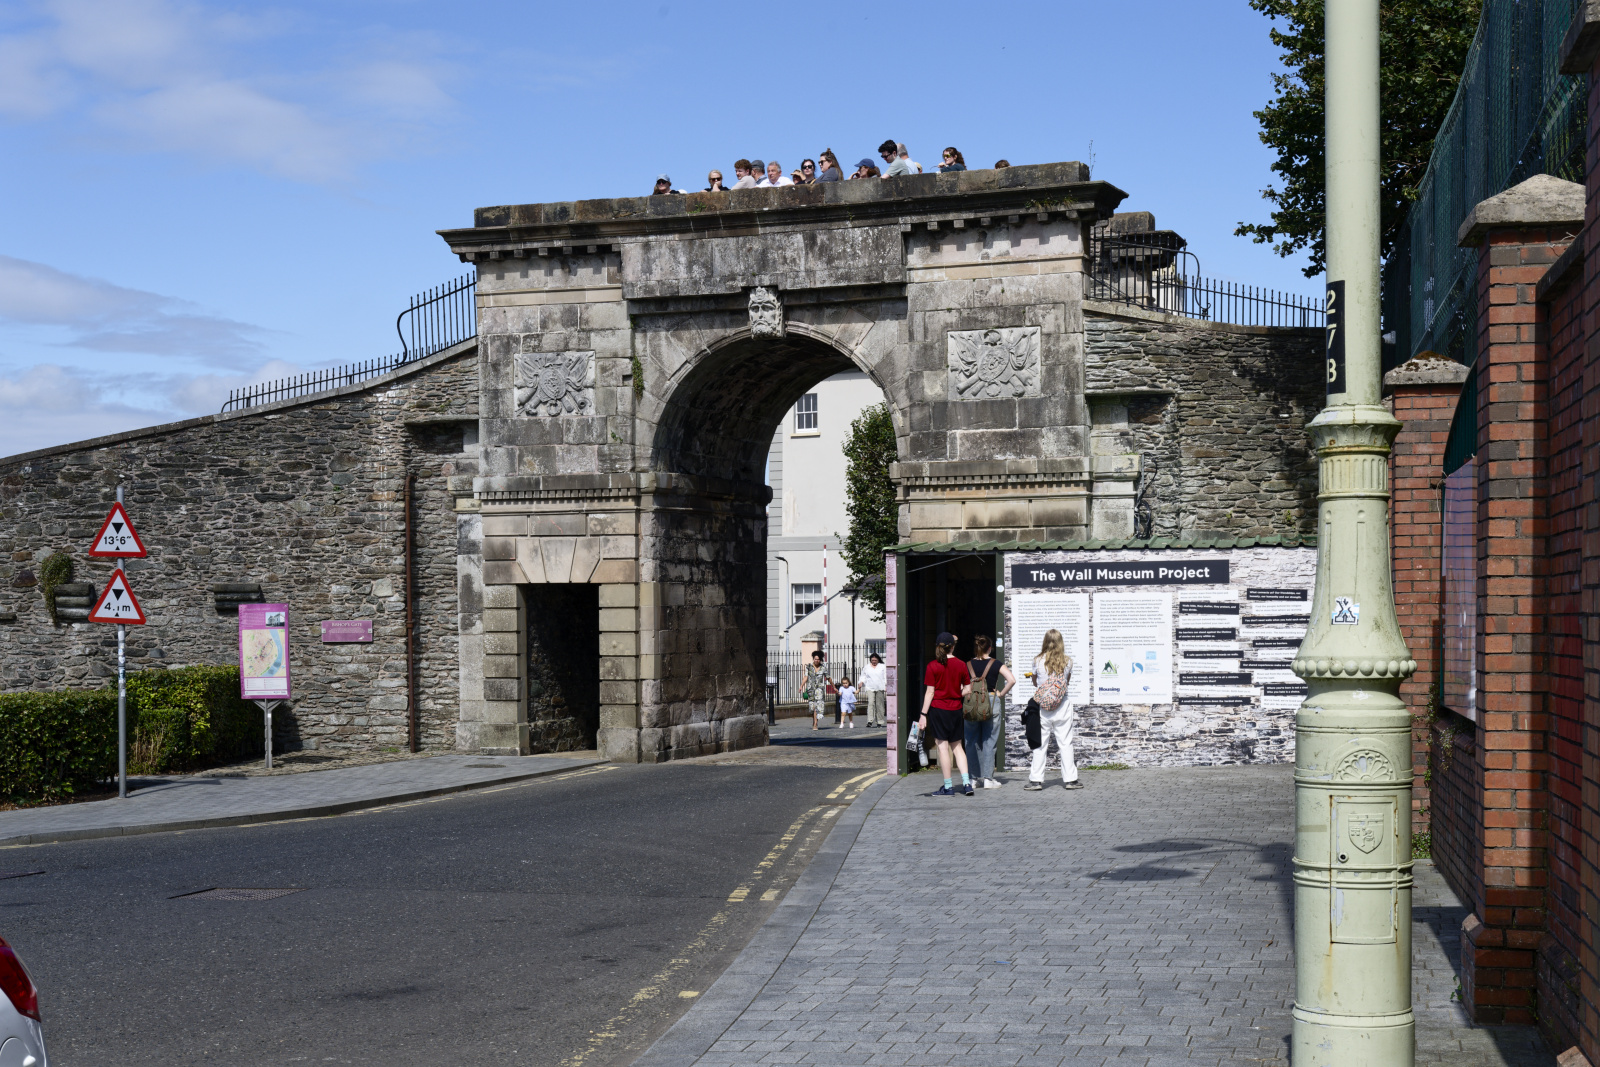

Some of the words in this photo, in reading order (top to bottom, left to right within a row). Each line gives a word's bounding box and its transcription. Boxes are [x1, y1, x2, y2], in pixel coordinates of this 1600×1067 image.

[1030, 569, 1056, 581] The
[1060, 569, 1092, 581] Wall
[1096, 568, 1154, 580] Museum
[1159, 566, 1210, 581] Project
